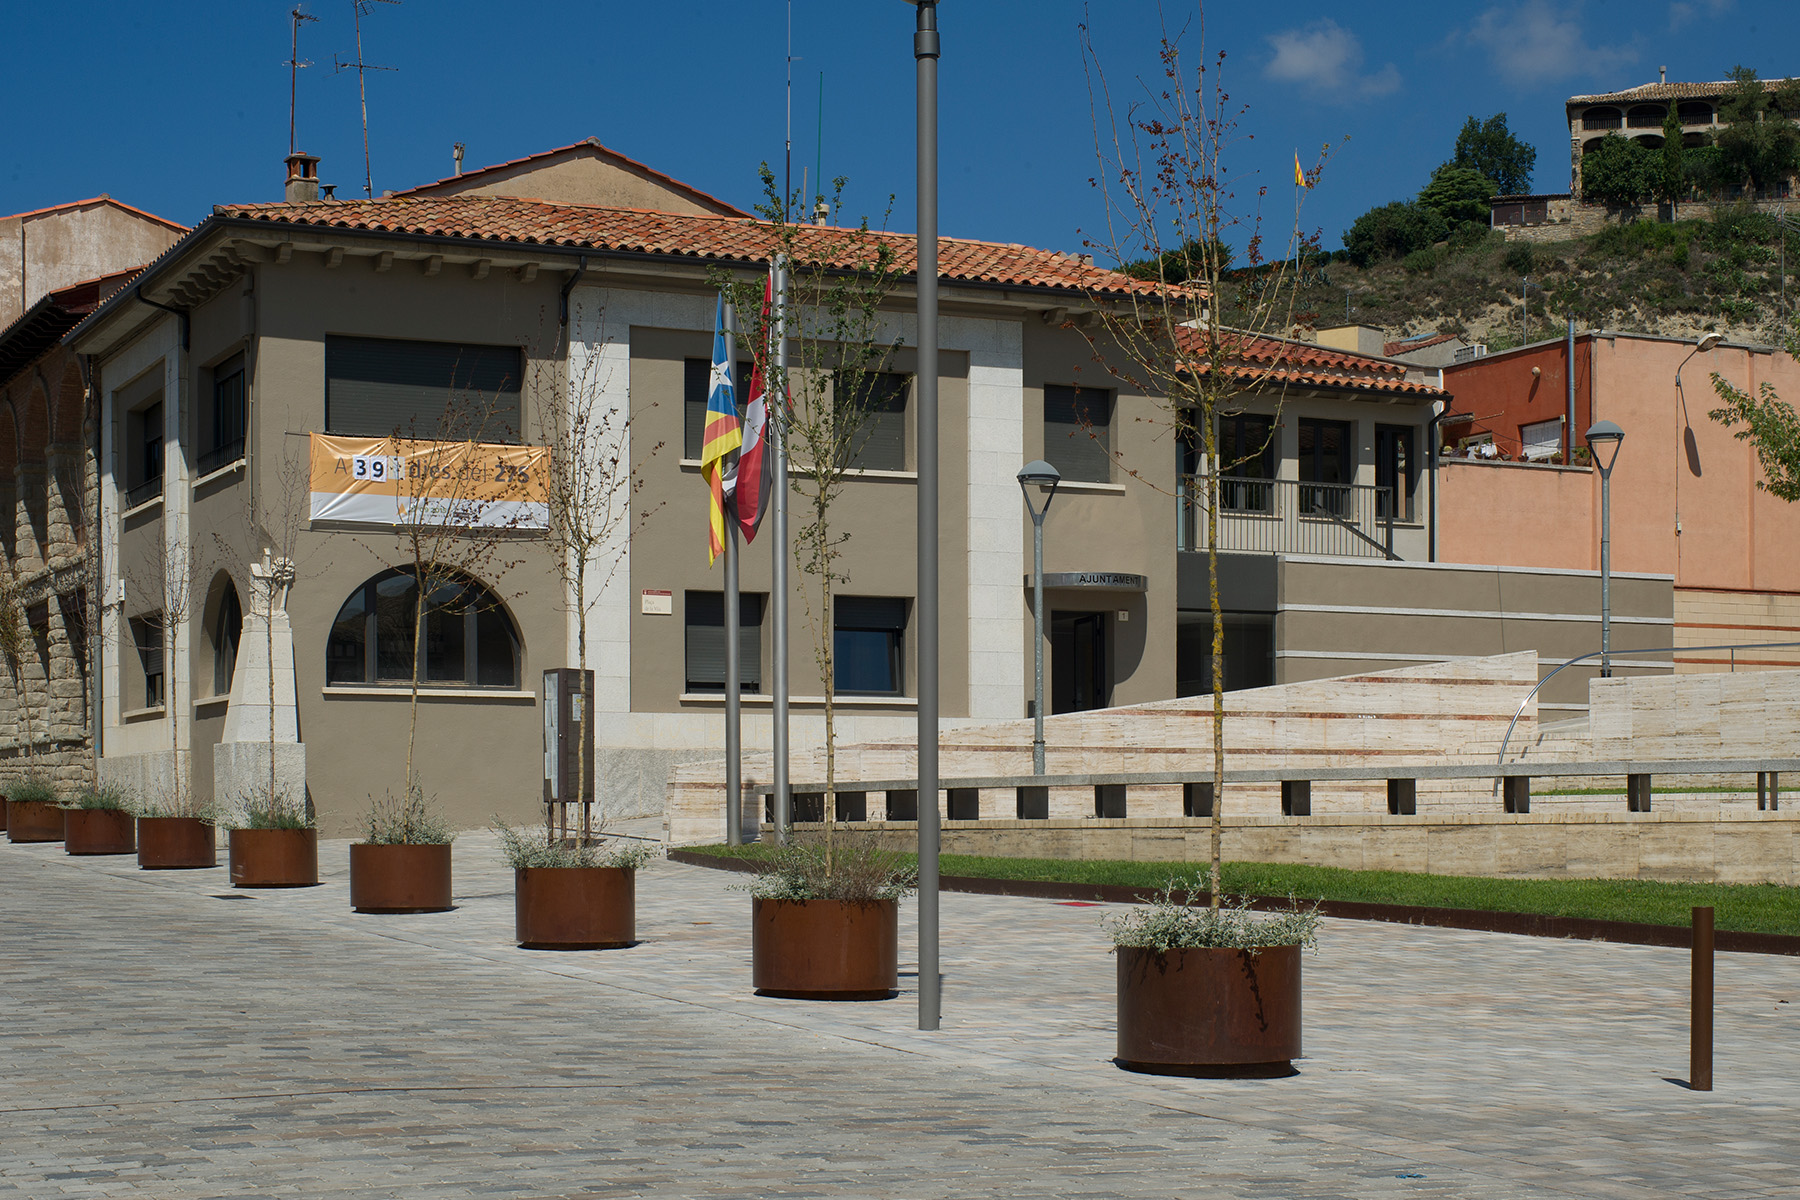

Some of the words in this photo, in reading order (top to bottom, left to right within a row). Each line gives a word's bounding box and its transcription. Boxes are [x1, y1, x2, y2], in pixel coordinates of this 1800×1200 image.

[334, 457, 347, 475] A
[356, 459, 384, 478] 39
[409, 459, 451, 479] dies
[458, 462, 487, 482] del
[1079, 574, 1138, 584] AJUNTAMENT
